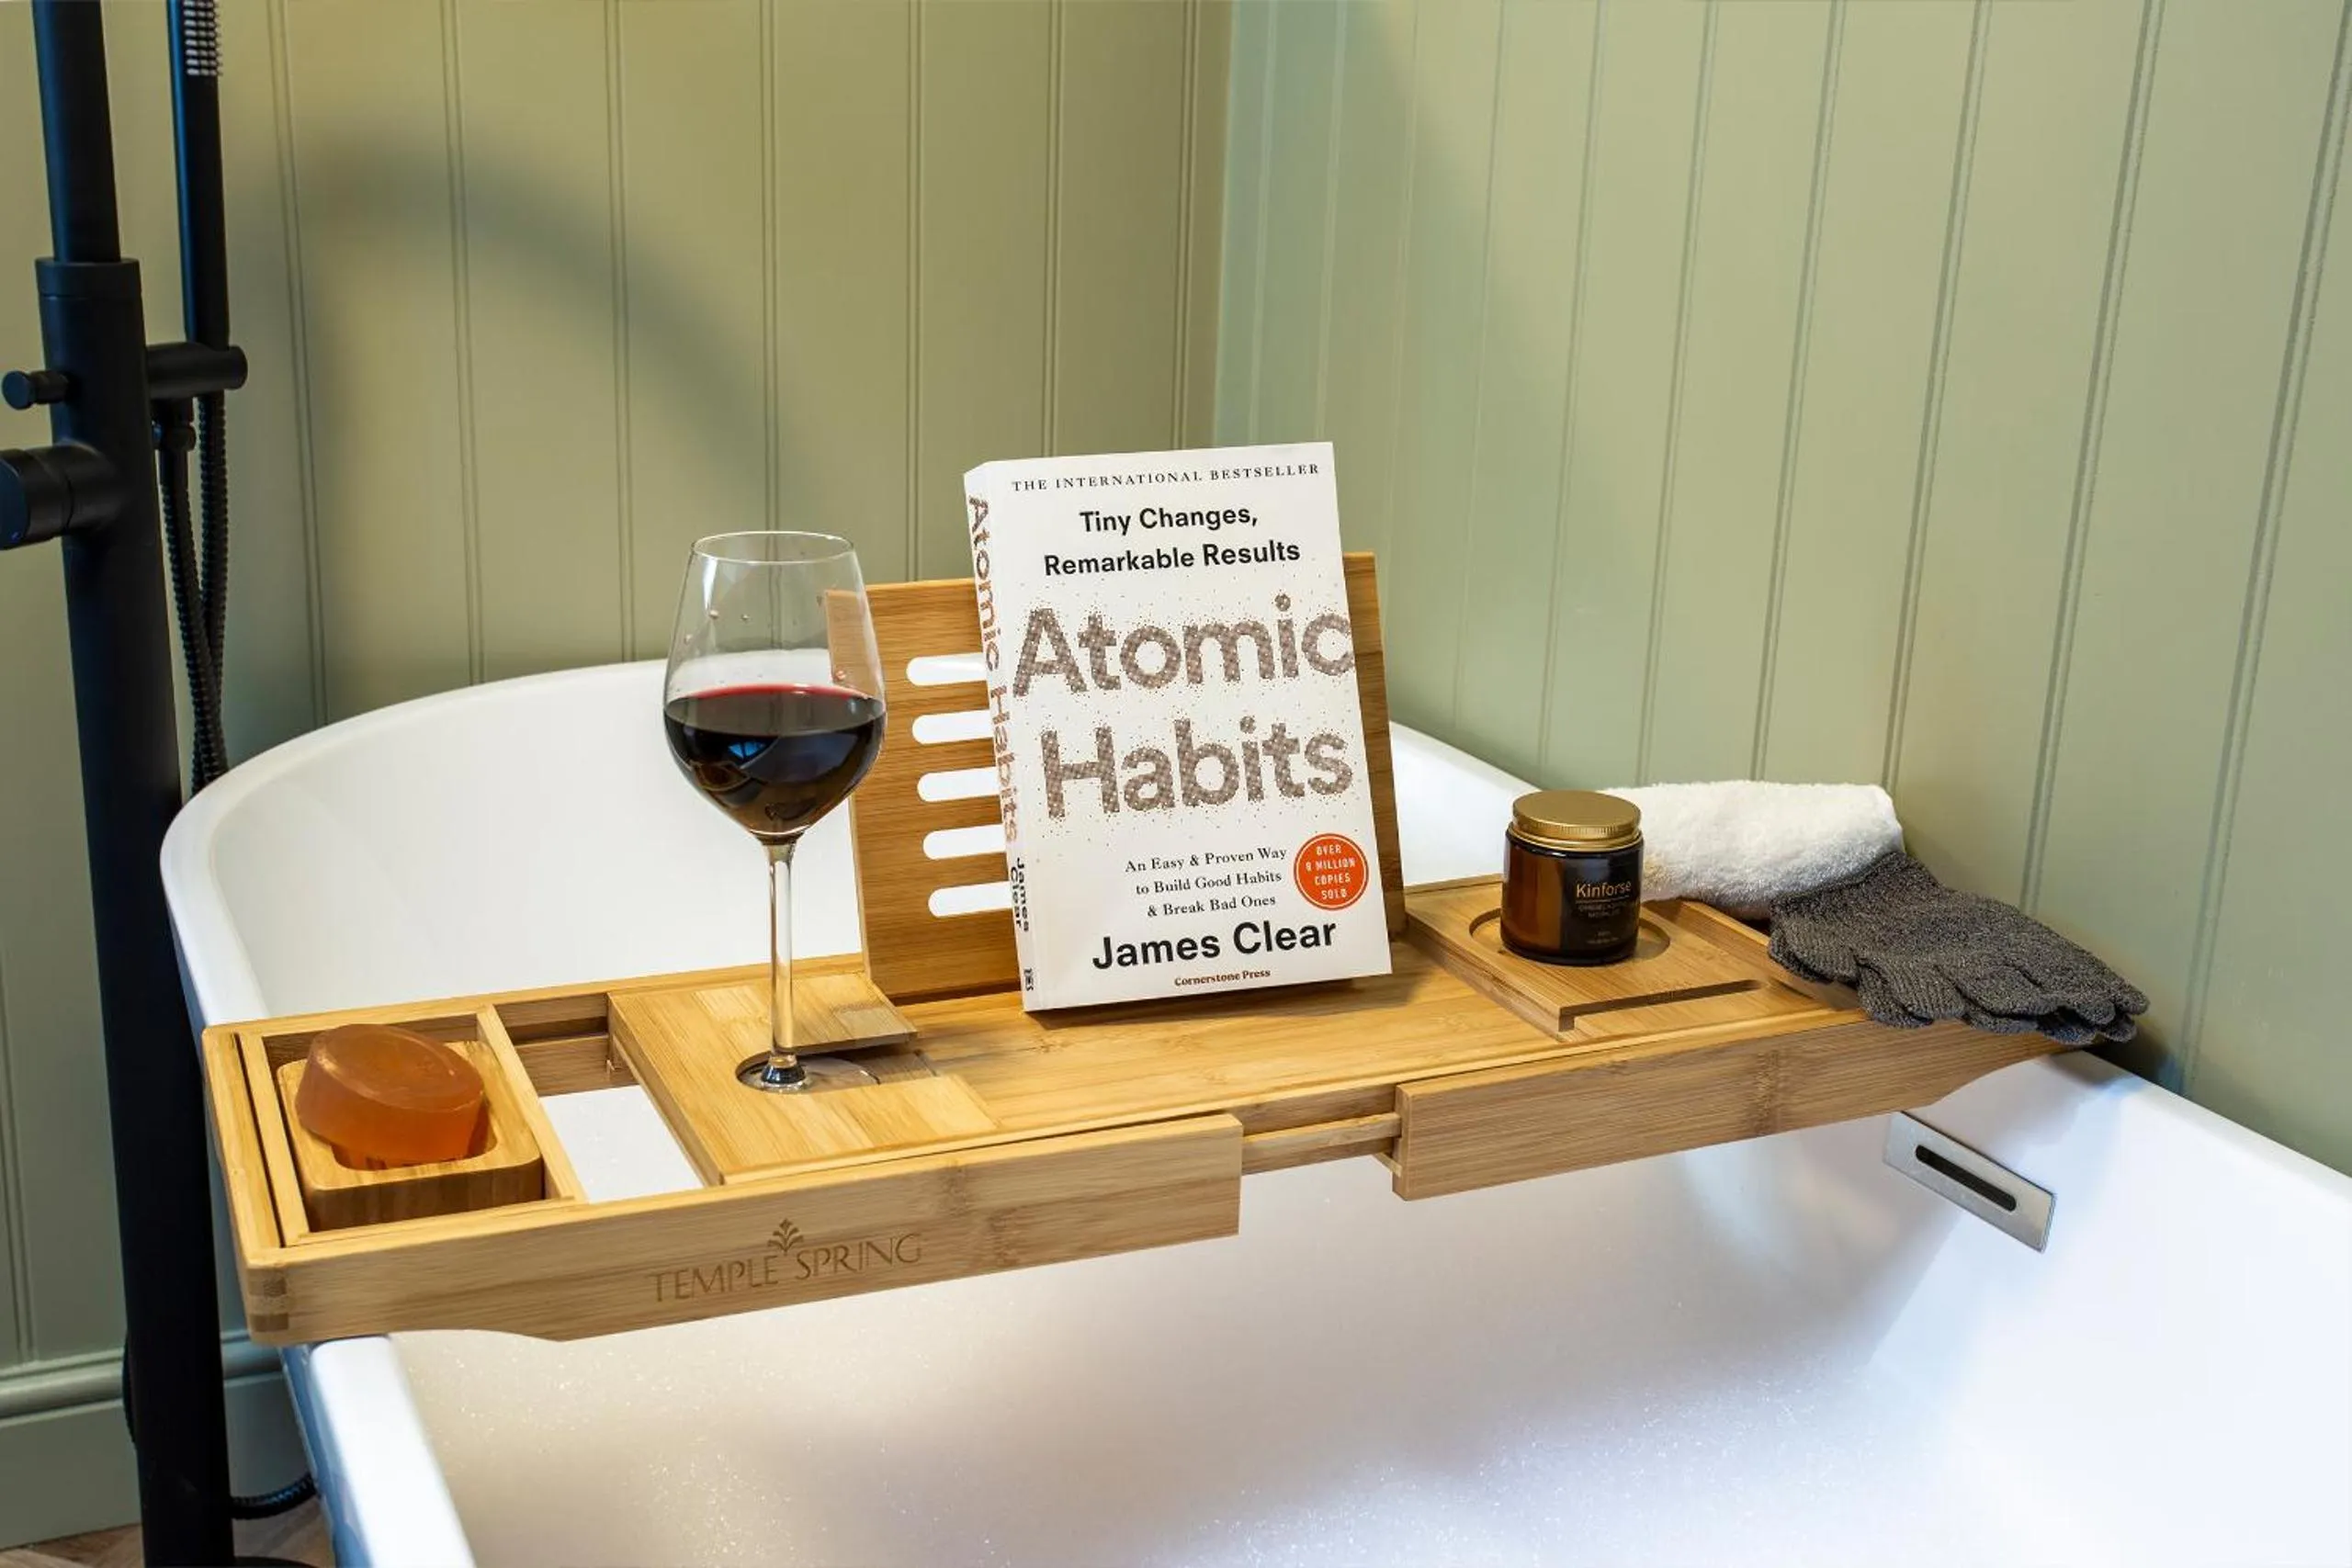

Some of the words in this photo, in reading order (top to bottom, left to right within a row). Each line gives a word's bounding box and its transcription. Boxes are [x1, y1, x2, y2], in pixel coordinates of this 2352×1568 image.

[1012, 479, 1047, 492] THE
[1056, 470, 1203, 489] INTERNATIONAL
[1210, 463, 1320, 481] BESTSELLER
[1080, 511, 1131, 536] Tiny
[1138, 506, 1259, 530] Changes,
[1045, 546, 1195, 577] Remarkable
[1203, 540, 1302, 567] Results
[969, 496, 1001, 672] Atomic
[1012, 592, 1355, 698] Atomic
[1041, 713, 1355, 822] Habits
[1125, 859, 1146, 873] An
[1151, 855, 1185, 871] Easy
[1190, 853, 1200, 867] &
[1204, 851, 1253, 866] Proven
[1261, 847, 1288, 862] Way
[1315, 857, 1356, 871] MILLION
[1136, 884, 1149, 896] to
[1154, 878, 1192, 893] Build
[1194, 875, 1232, 890] Good
[1236, 871, 1283, 886] Habits
[1314, 873, 1351, 886] COPIES
[1576, 881, 1632, 898] Kinforse
[1147, 905, 1158, 918] &
[1163, 900, 1205, 916] Break
[1210, 897, 1238, 911] Bad
[1241, 894, 1276, 909] Ones
[1091, 933, 1220, 970] James
[1232, 919, 1337, 954] Clear
[1173, 971, 1241, 987] Cornerstone
[1242, 968, 1272, 980] Press
[649, 1255, 779, 1303] TEMPLE
[795, 1232, 922, 1280] SPRING
